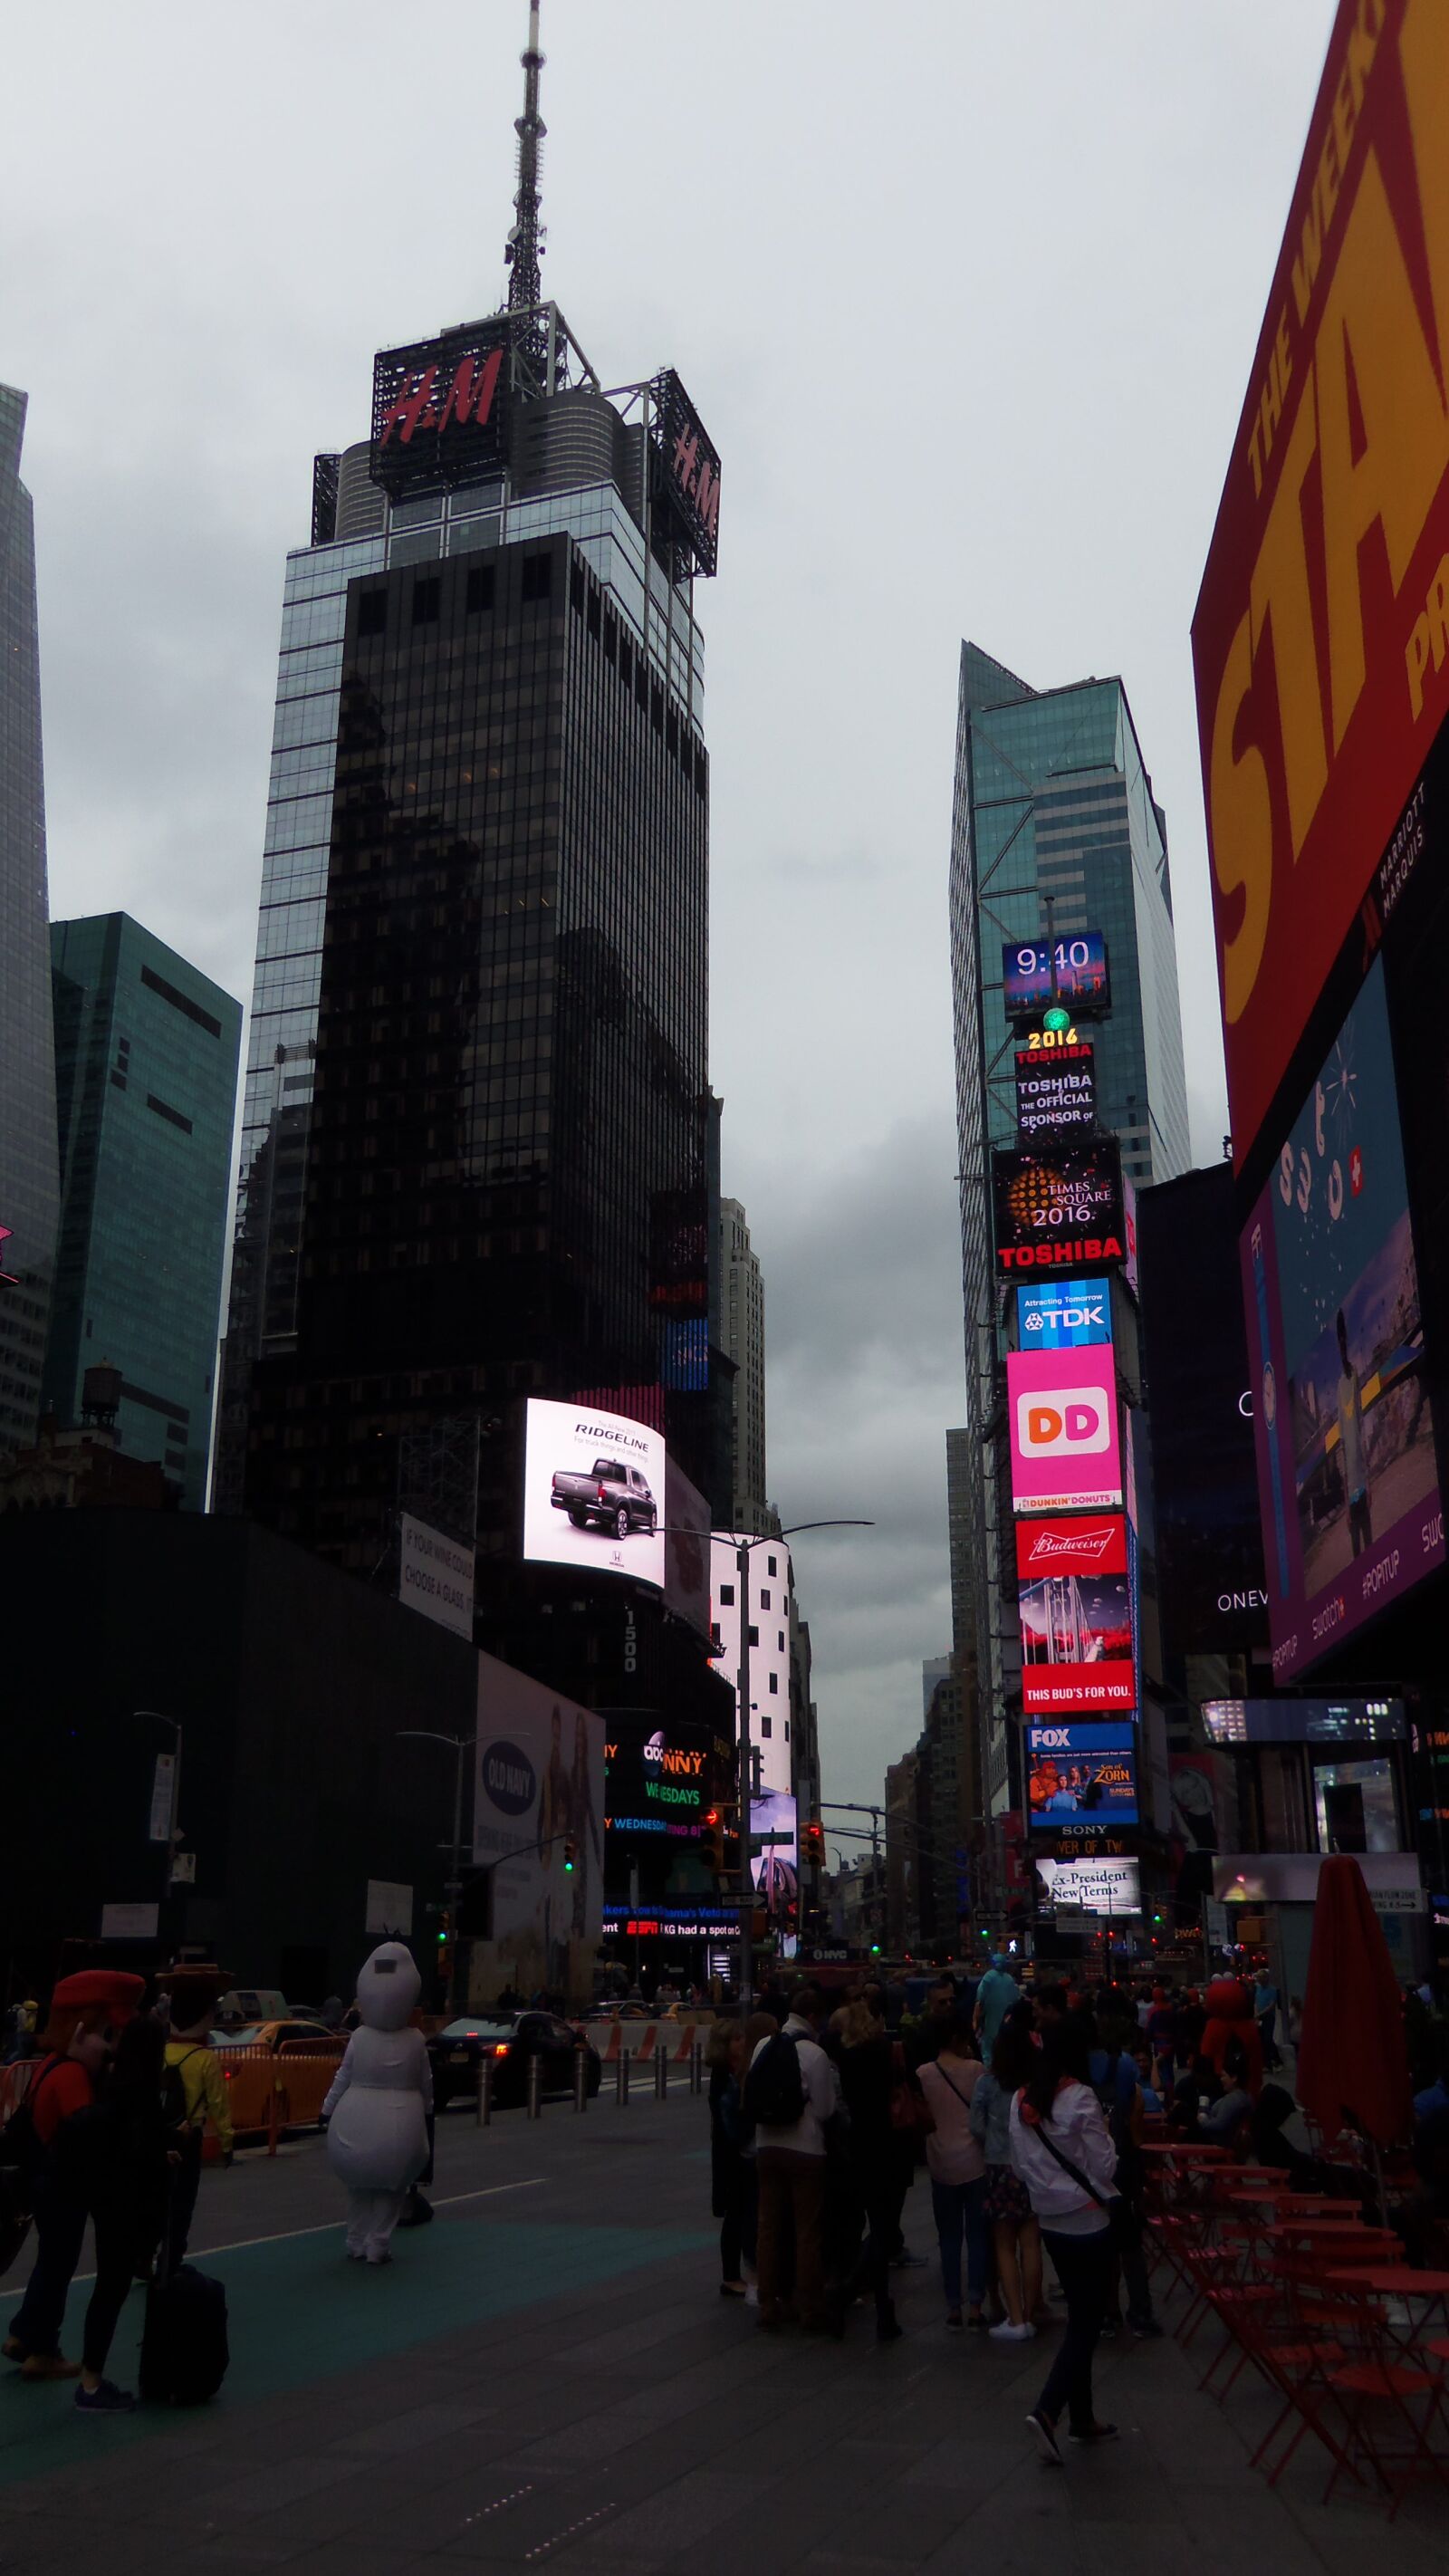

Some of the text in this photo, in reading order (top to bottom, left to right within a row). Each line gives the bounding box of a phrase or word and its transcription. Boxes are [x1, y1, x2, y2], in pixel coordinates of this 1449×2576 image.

[379, 349, 504, 450] H&M
[1248, 303, 1293, 500] THE
[673, 422, 720, 539] H&M
[1379, 782, 1425, 890] MARRIOTT
[1383, 825, 1424, 918] MARQUIS
[1016, 941, 1089, 976] 9:40
[1028, 1028, 1078, 1050] 2016
[1015, 1043, 1093, 1065] TOSHIBA
[1018, 1074, 1092, 1094] TOSHIBA
[1021, 1092, 1093, 1110] THE OFFICIAL
[1021, 1110, 1094, 1127] SPONSOR OF
[1047, 1181, 1090, 1195] TIMES
[1056, 1190, 1111, 1206] SQUARE
[998, 1236, 1122, 1268] TOSHIBA
[1024, 1293, 1103, 1307] Attracting Tomorrow
[1043, 1306, 1105, 1329] TDK
[575, 1424, 649, 1453] RIDGELINE
[1030, 1495, 1110, 1507] DUNKIN' DONUTS
[1033, 1538, 1108, 1553] Budweiser
[405, 1564, 436, 1595] CHOOSE
[1362, 1549, 1400, 1600] #POPITUP
[1312, 1597, 1340, 1640] swatch
[625, 1610, 637, 1674] 1500
[1027, 1686, 1131, 1700] THIS BUD'S FOR YOU.
[1031, 1728, 1071, 1748] FOX
[488, 1757, 532, 1798] OLD NAVY
[1094, 1769, 1130, 1784] ZORN
[1061, 1825, 1108, 1835] SONY
[1084, 1840, 1099, 1855] OF
[1052, 1870, 1128, 1885] Ex-President
[1052, 1885, 1118, 1899] New Terms
[678, 1925, 697, 1935] had
[699, 1927, 706, 1935] a
[709, 1926, 726, 1937] spot
